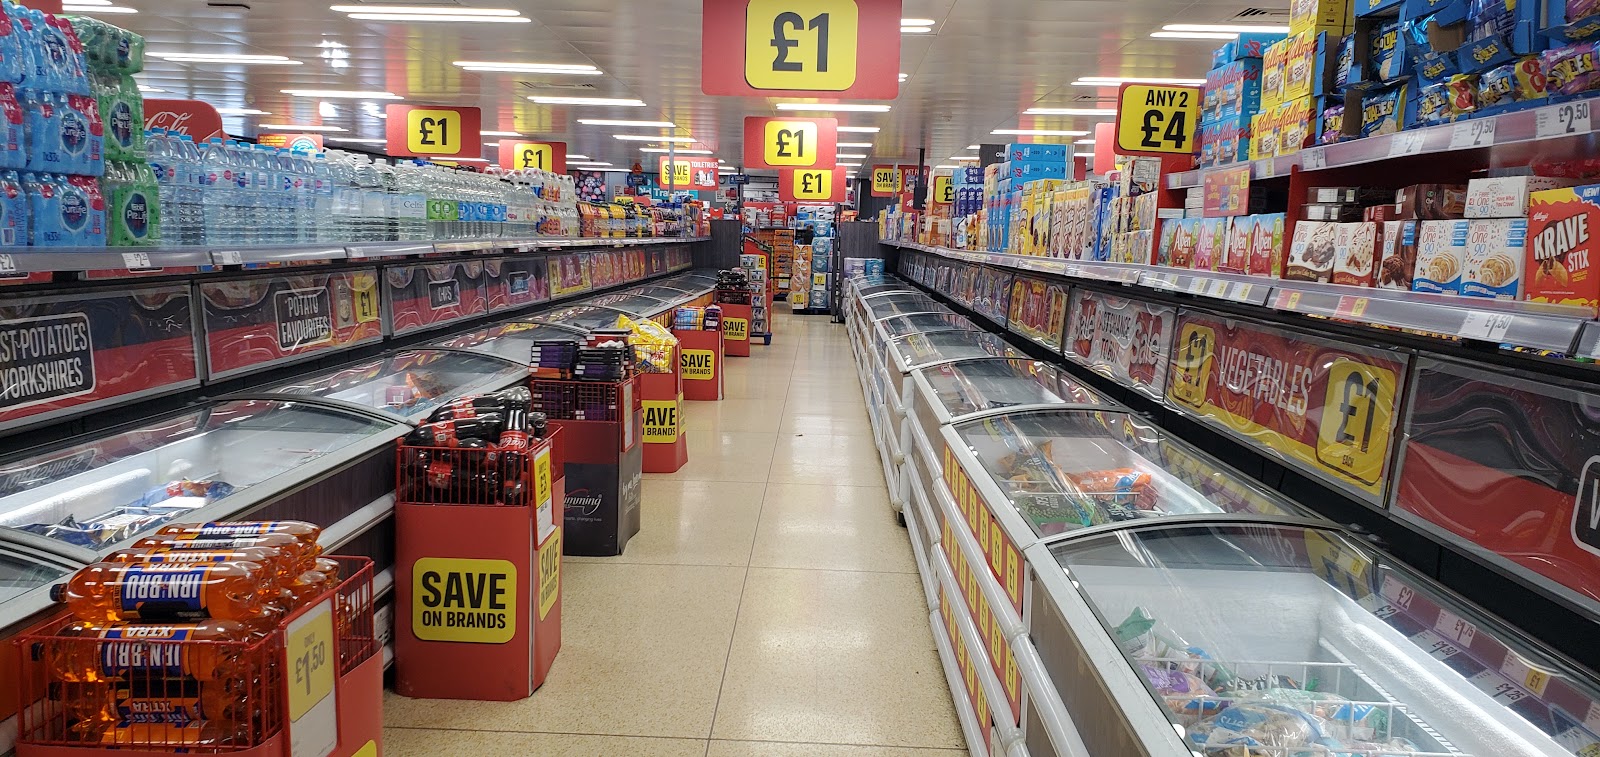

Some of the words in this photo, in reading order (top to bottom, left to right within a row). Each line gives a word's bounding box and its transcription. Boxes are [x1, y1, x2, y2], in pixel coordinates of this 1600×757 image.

[770, 11, 830, 73] £1
[1145, 89, 1173, 107] ANY
[1178, 91, 1189, 108] 2
[1141, 110, 1187, 149] £4
[1558, 103, 1589, 134] £2.50
[419, 117, 448, 146] £1
[1470, 120, 1495, 146] £2.50
[776, 129, 804, 158] £1
[522, 149, 544, 171] £1
[691, 161, 719, 169] TOILETRIES
[802, 172, 823, 194] £1
[1582, 187, 1600, 198] NEW!
[403, 200, 424, 209] Celtic
[1173, 225, 1192, 252] Alpen
[1251, 224, 1272, 255] Alpen
[1422, 231, 1437, 244] One
[1471, 231, 1489, 244] One
[1533, 212, 1590, 261] KRAVE
[1424, 243, 1435, 255] 90
[1473, 243, 1487, 257] 90
[1568, 248, 1590, 273] STIX
[287, 295, 319, 318] POTATO
[360, 290, 372, 317] £1
[281, 315, 329, 344] FAVOURITES
[723, 320, 745, 332] SAVE
[1484, 312, 1510, 338] £1.50
[0, 330, 18, 363] ST
[20, 322, 88, 360] POTATOES
[1130, 319, 1160, 366] Sale
[681, 353, 711, 368] SAVE
[0, 357, 84, 400] YORKSHIRES
[1218, 345, 1313, 417] VEGETABLES
[642, 407, 676, 426] AVE
[1335, 370, 1380, 454] £1
[646, 427, 676, 436] BRANDS
[168, 552, 211, 563] XTRA
[541, 538, 559, 588] SAVE
[421, 570, 507, 610] SAVE
[1396, 586, 1413, 609] £2
[422, 610, 442, 627] ON
[446, 611, 506, 629] BRANDS
[1454, 619, 1474, 642] £1.75
[126, 626, 173, 637] XTRA
[1430, 640, 1458, 656] £1.50
[295, 640, 325, 696] £1.50
[1492, 682, 1525, 701] £1.25
[1529, 676, 1541, 690] £1
